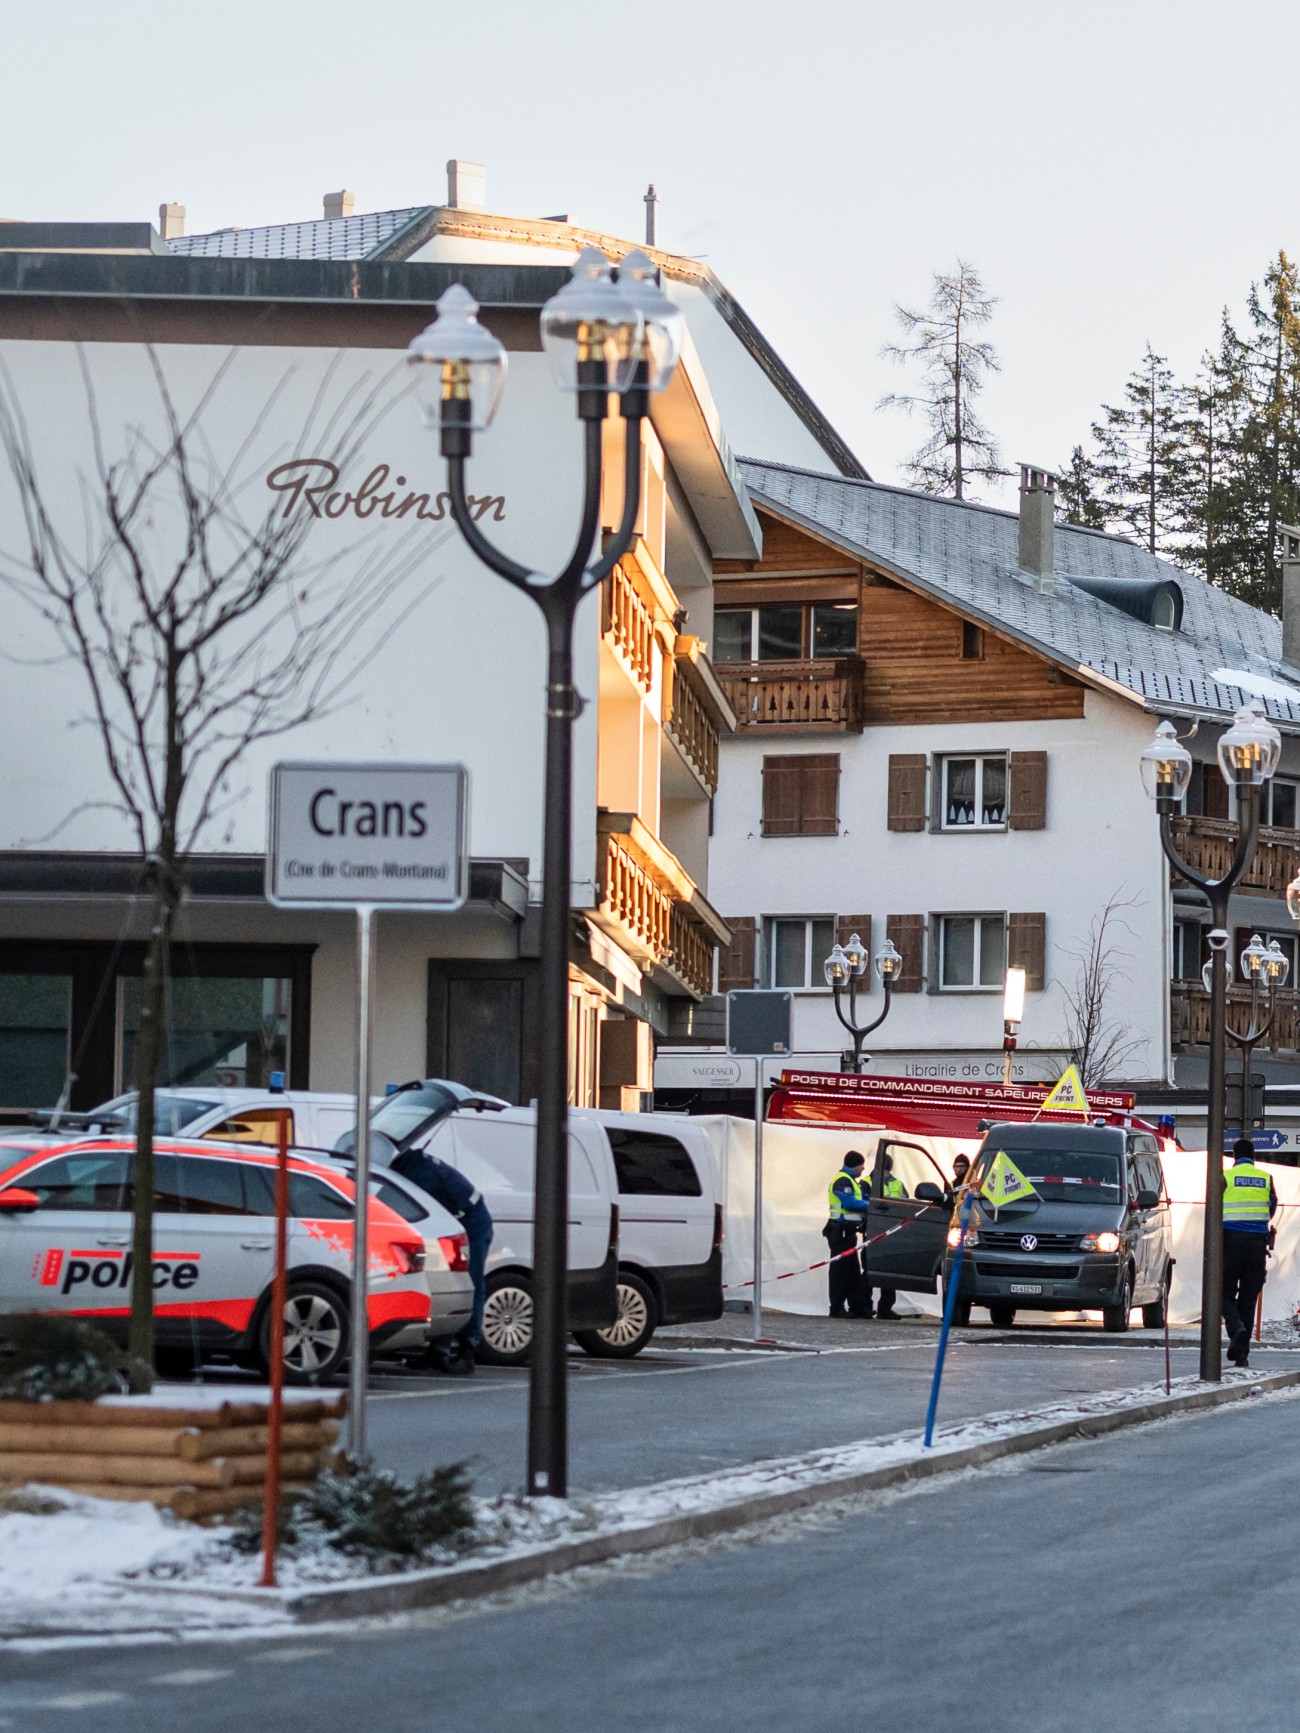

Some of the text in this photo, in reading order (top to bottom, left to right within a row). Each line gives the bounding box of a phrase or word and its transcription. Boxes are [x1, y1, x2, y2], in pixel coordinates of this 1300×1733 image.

[266, 458, 506, 522] Robinsn
[309, 788, 428, 837] Crans
[905, 1064, 957, 1077] Librairie
[962, 1063, 980, 1076] de
[790, 1074, 837, 1086] POSTE
[839, 1078, 858, 1087] DE
[861, 1080, 983, 1096] COMMANDEMENT
[1060, 1085, 1073, 1095] PC
[1055, 1095, 1075, 1103] FRONT
[1004, 1173, 1016, 1186] PC
[1235, 1177, 1265, 1187] POLICE
[1004, 1182, 1021, 1195] FRONT
[61, 1251, 199, 1295] polce
